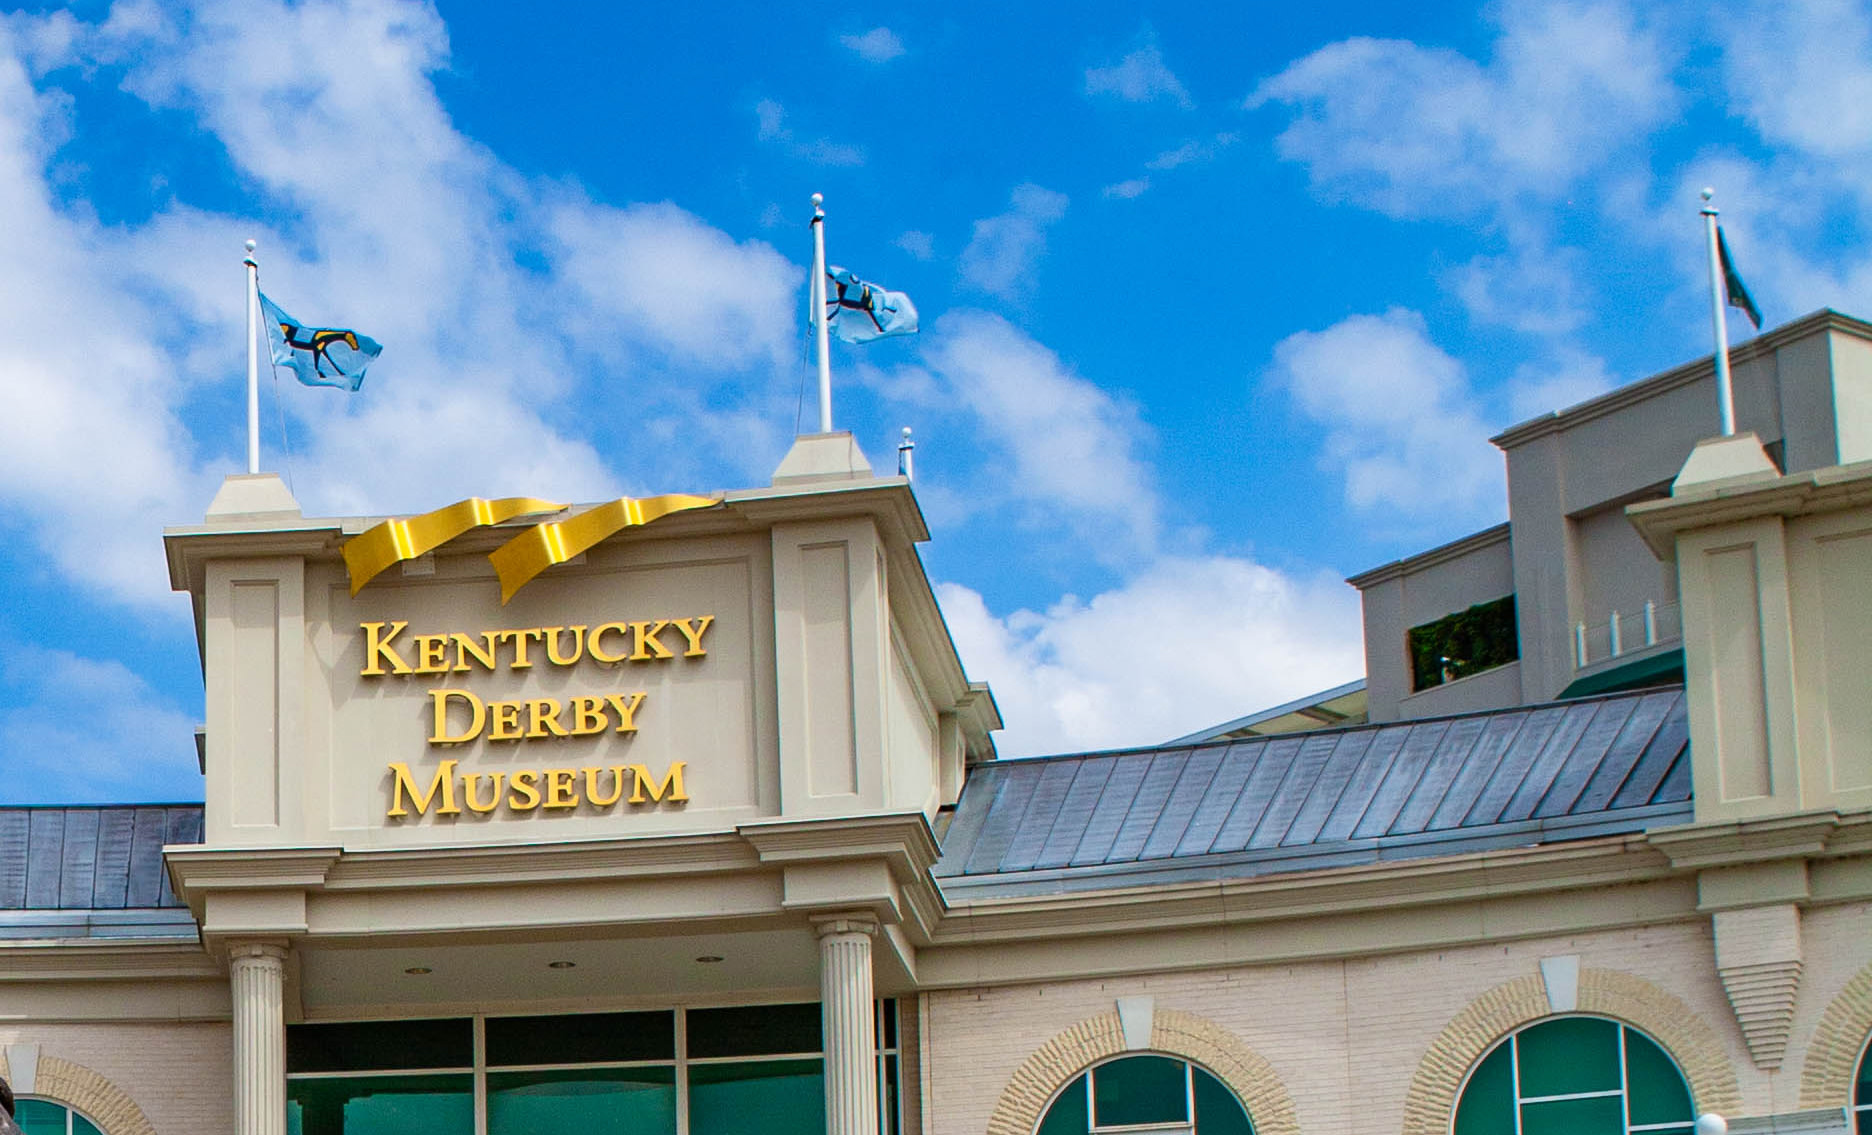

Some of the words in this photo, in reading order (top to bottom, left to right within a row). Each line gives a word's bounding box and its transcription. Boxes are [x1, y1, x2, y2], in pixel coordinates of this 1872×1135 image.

[359, 614, 715, 677] KENTUCKY
[427, 688, 648, 745] DERBY
[386, 759, 690, 818] MUSEUM
